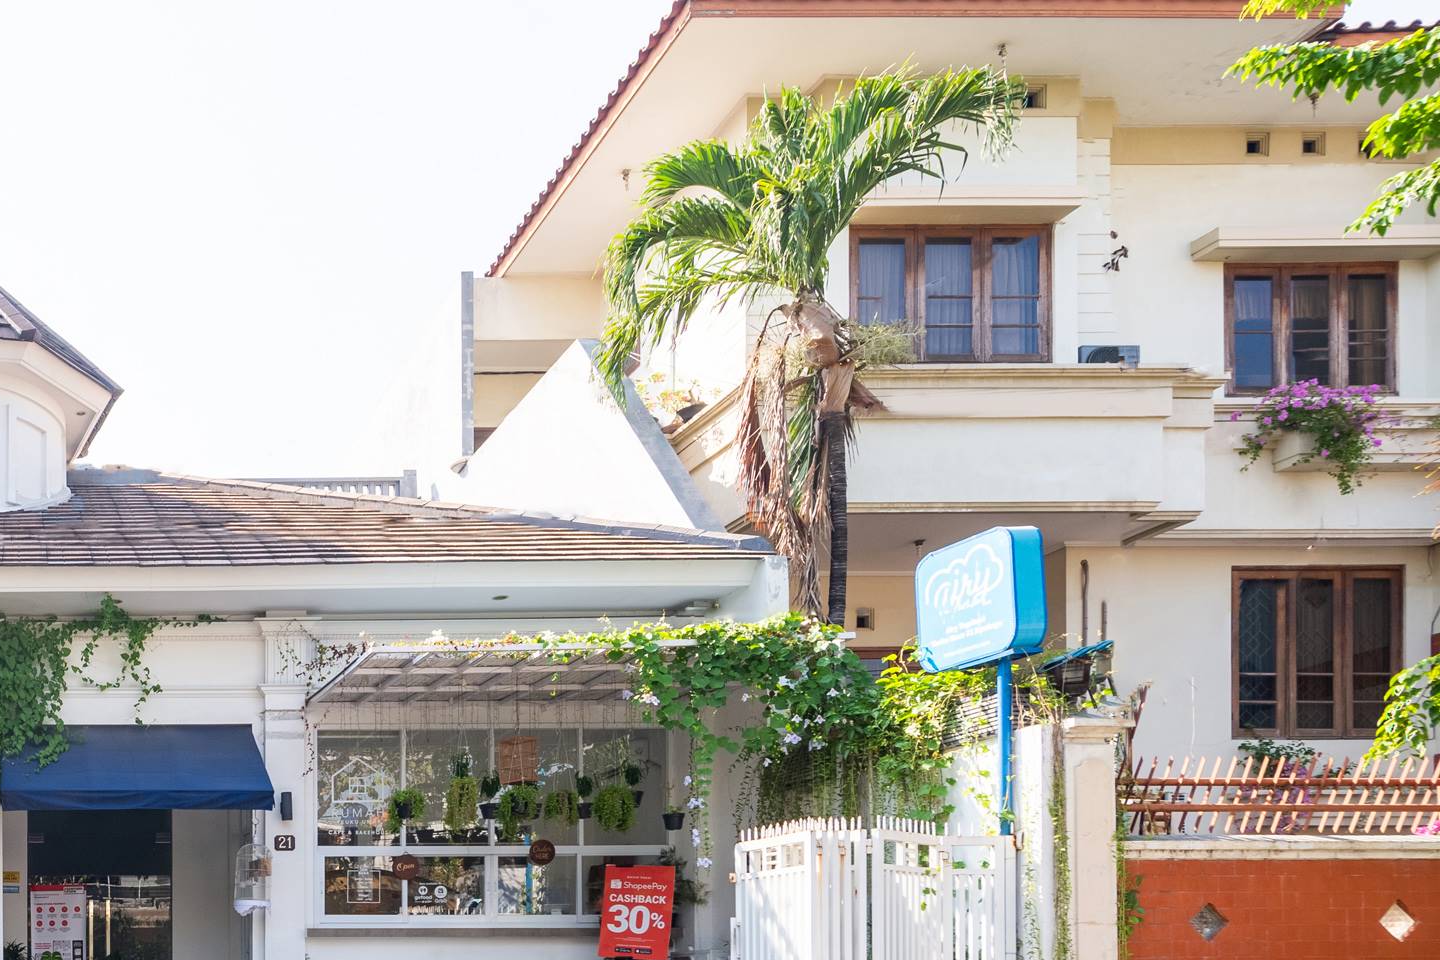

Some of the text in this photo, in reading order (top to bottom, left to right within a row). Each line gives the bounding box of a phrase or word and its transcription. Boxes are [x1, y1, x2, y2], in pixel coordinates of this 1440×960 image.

[278, 836, 292, 849] 21
[396, 863, 415, 872] Open
[623, 881, 668, 892] ShopeePay
[609, 893, 666, 904] CASHBACK
[606, 904, 665, 934] 30%
